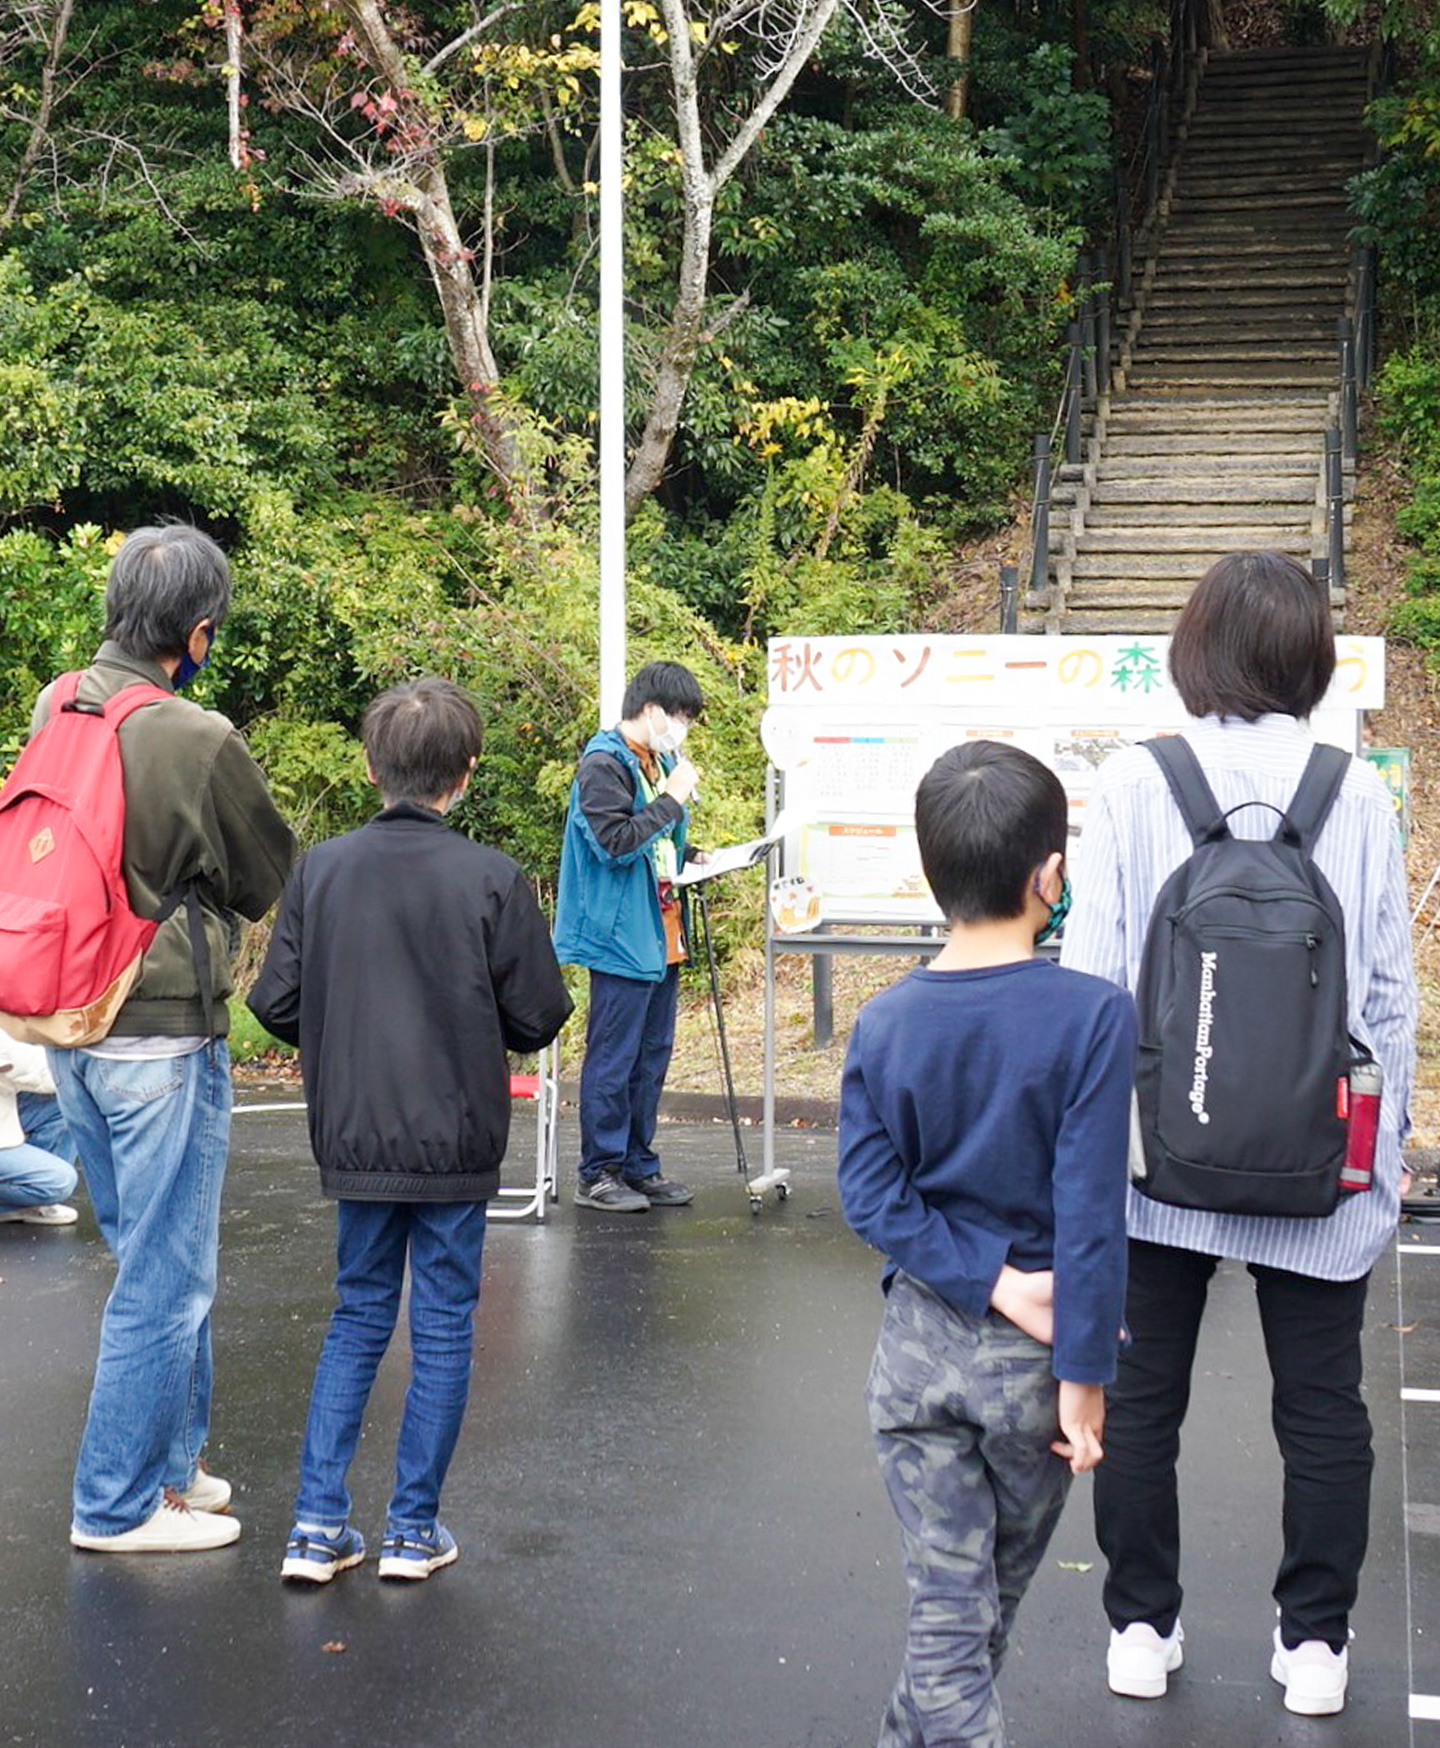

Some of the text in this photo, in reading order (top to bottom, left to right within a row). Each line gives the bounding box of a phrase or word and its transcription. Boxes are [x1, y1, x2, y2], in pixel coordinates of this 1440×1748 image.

[771, 642, 1163, 693] 秋のソニーの森
